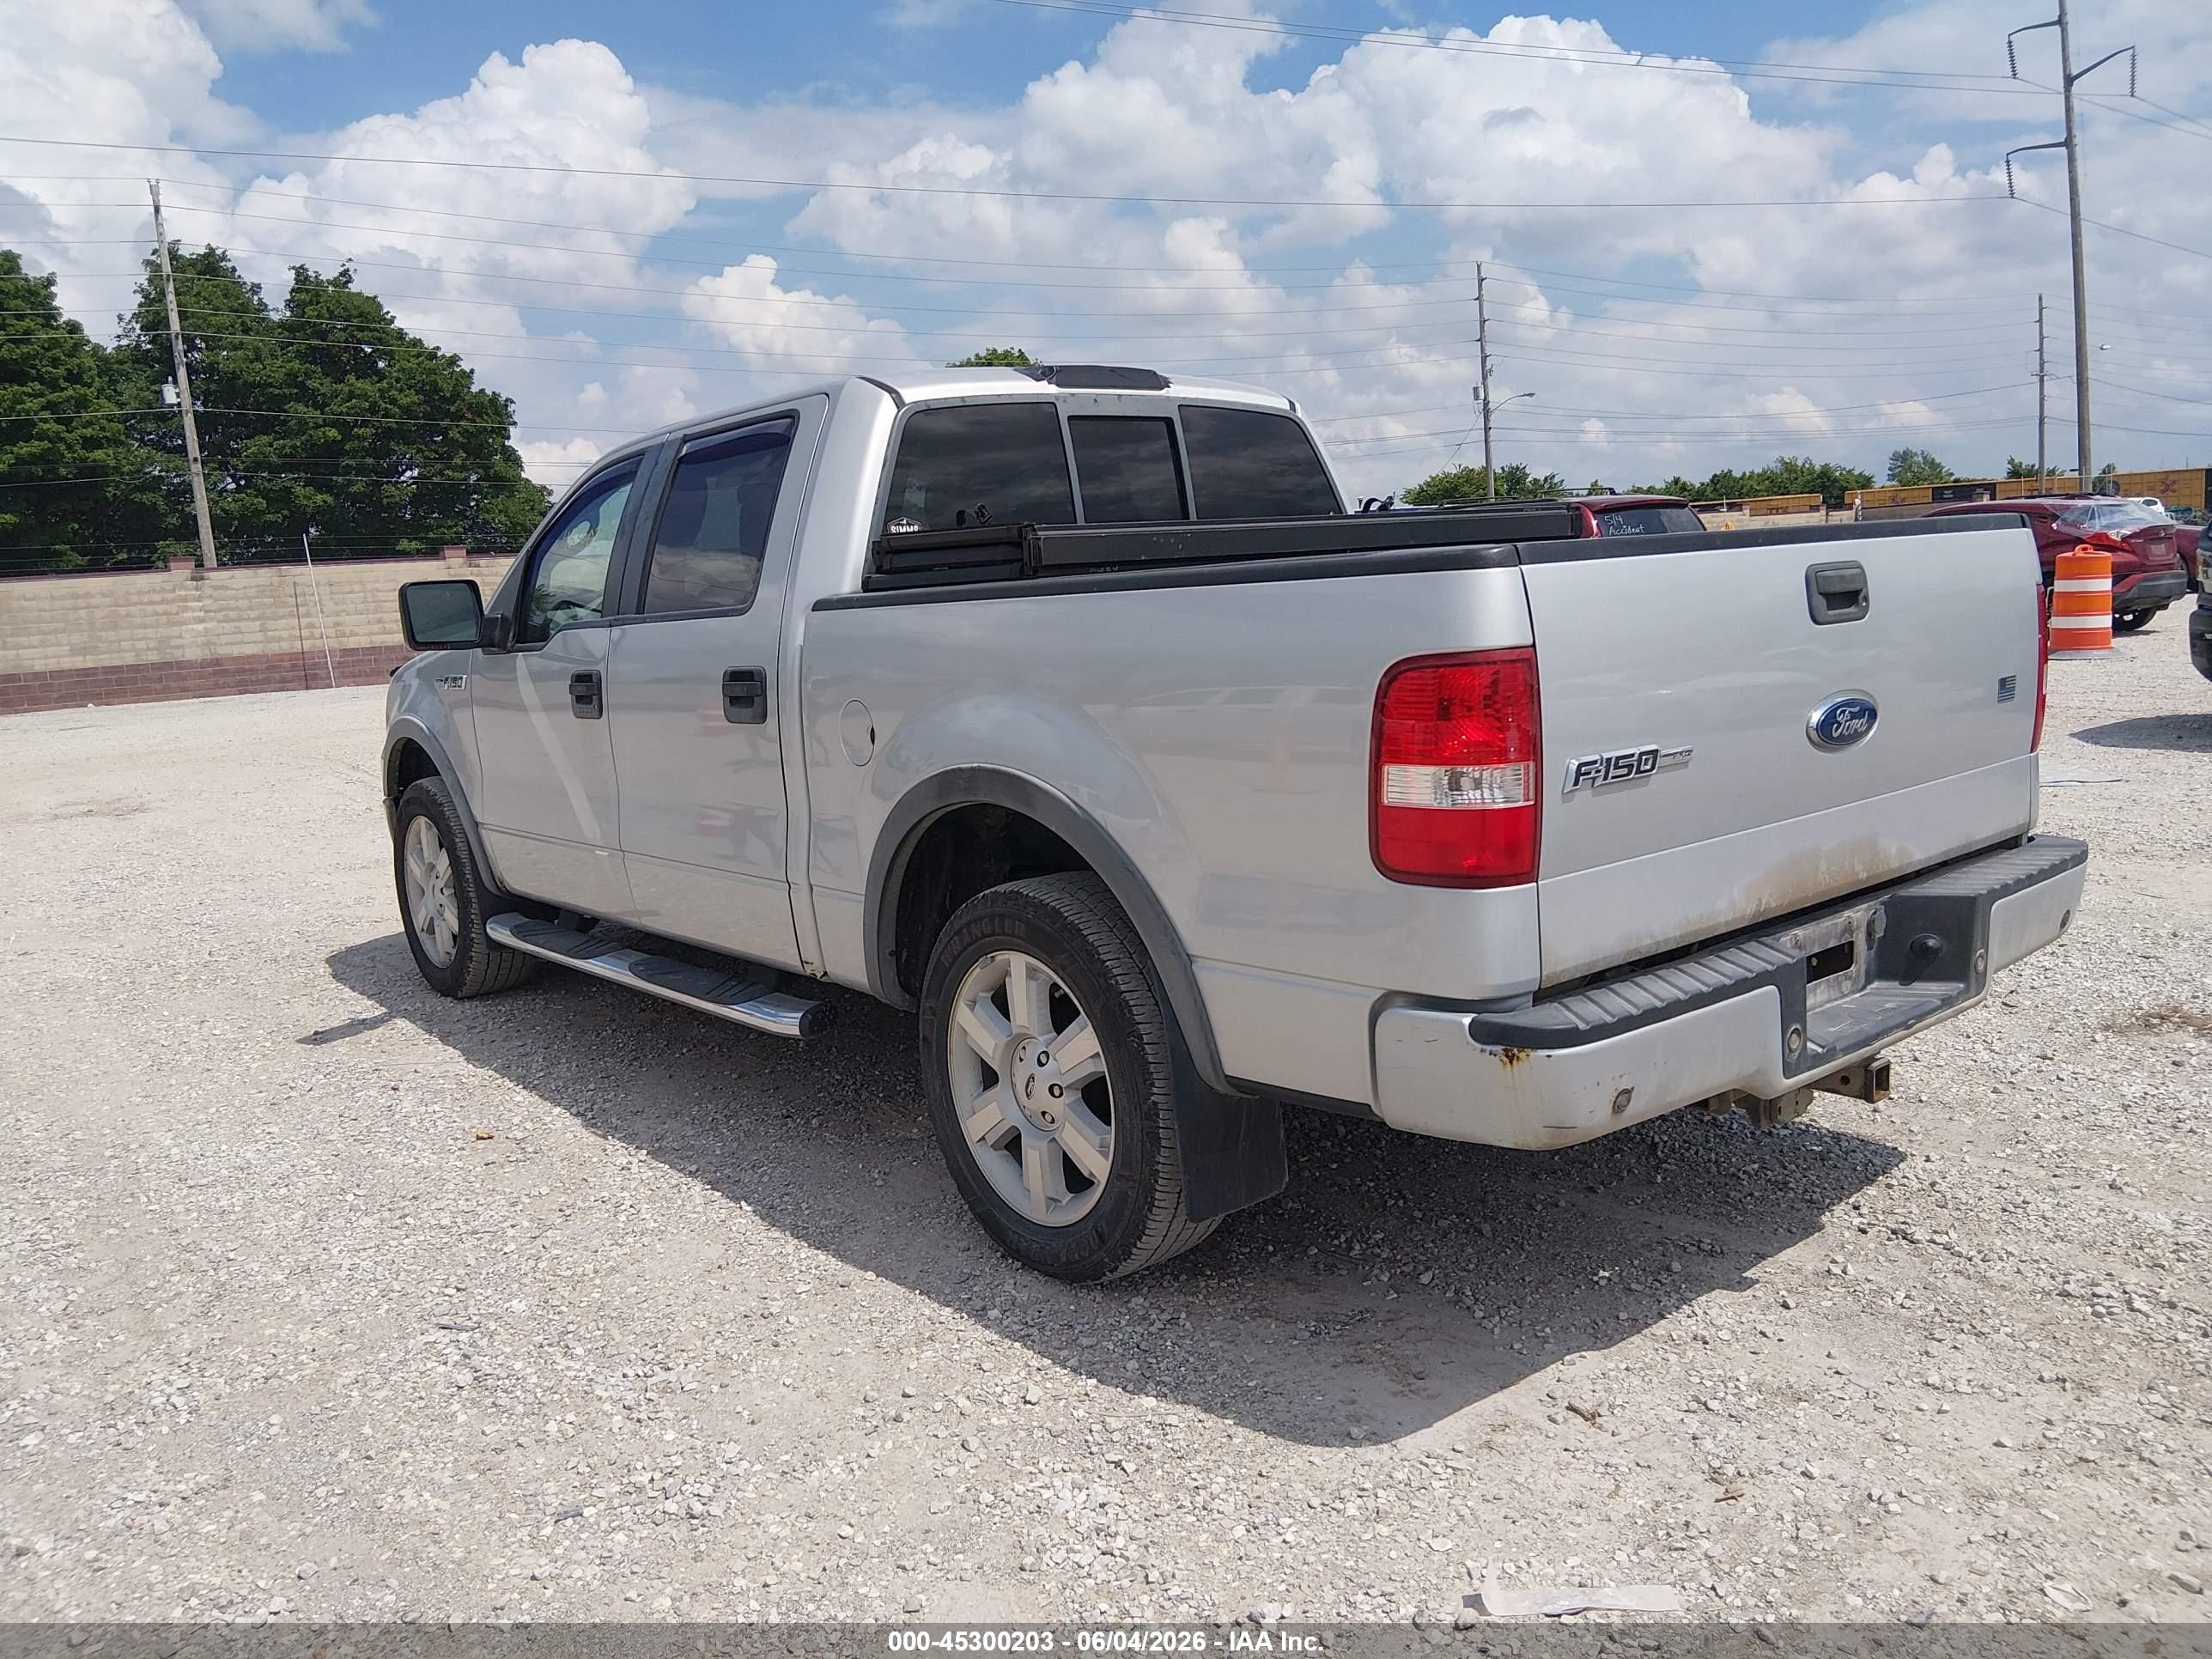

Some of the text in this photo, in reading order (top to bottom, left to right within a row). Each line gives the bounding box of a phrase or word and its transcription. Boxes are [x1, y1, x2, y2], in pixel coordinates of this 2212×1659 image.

[1604, 514, 1624, 526] 5/4
[1608, 524, 1644, 536] Accident
[1832, 706, 1869, 738] Ford
[1570, 748, 1659, 788] F-150
[941, 916, 1027, 968] WRANGLER
